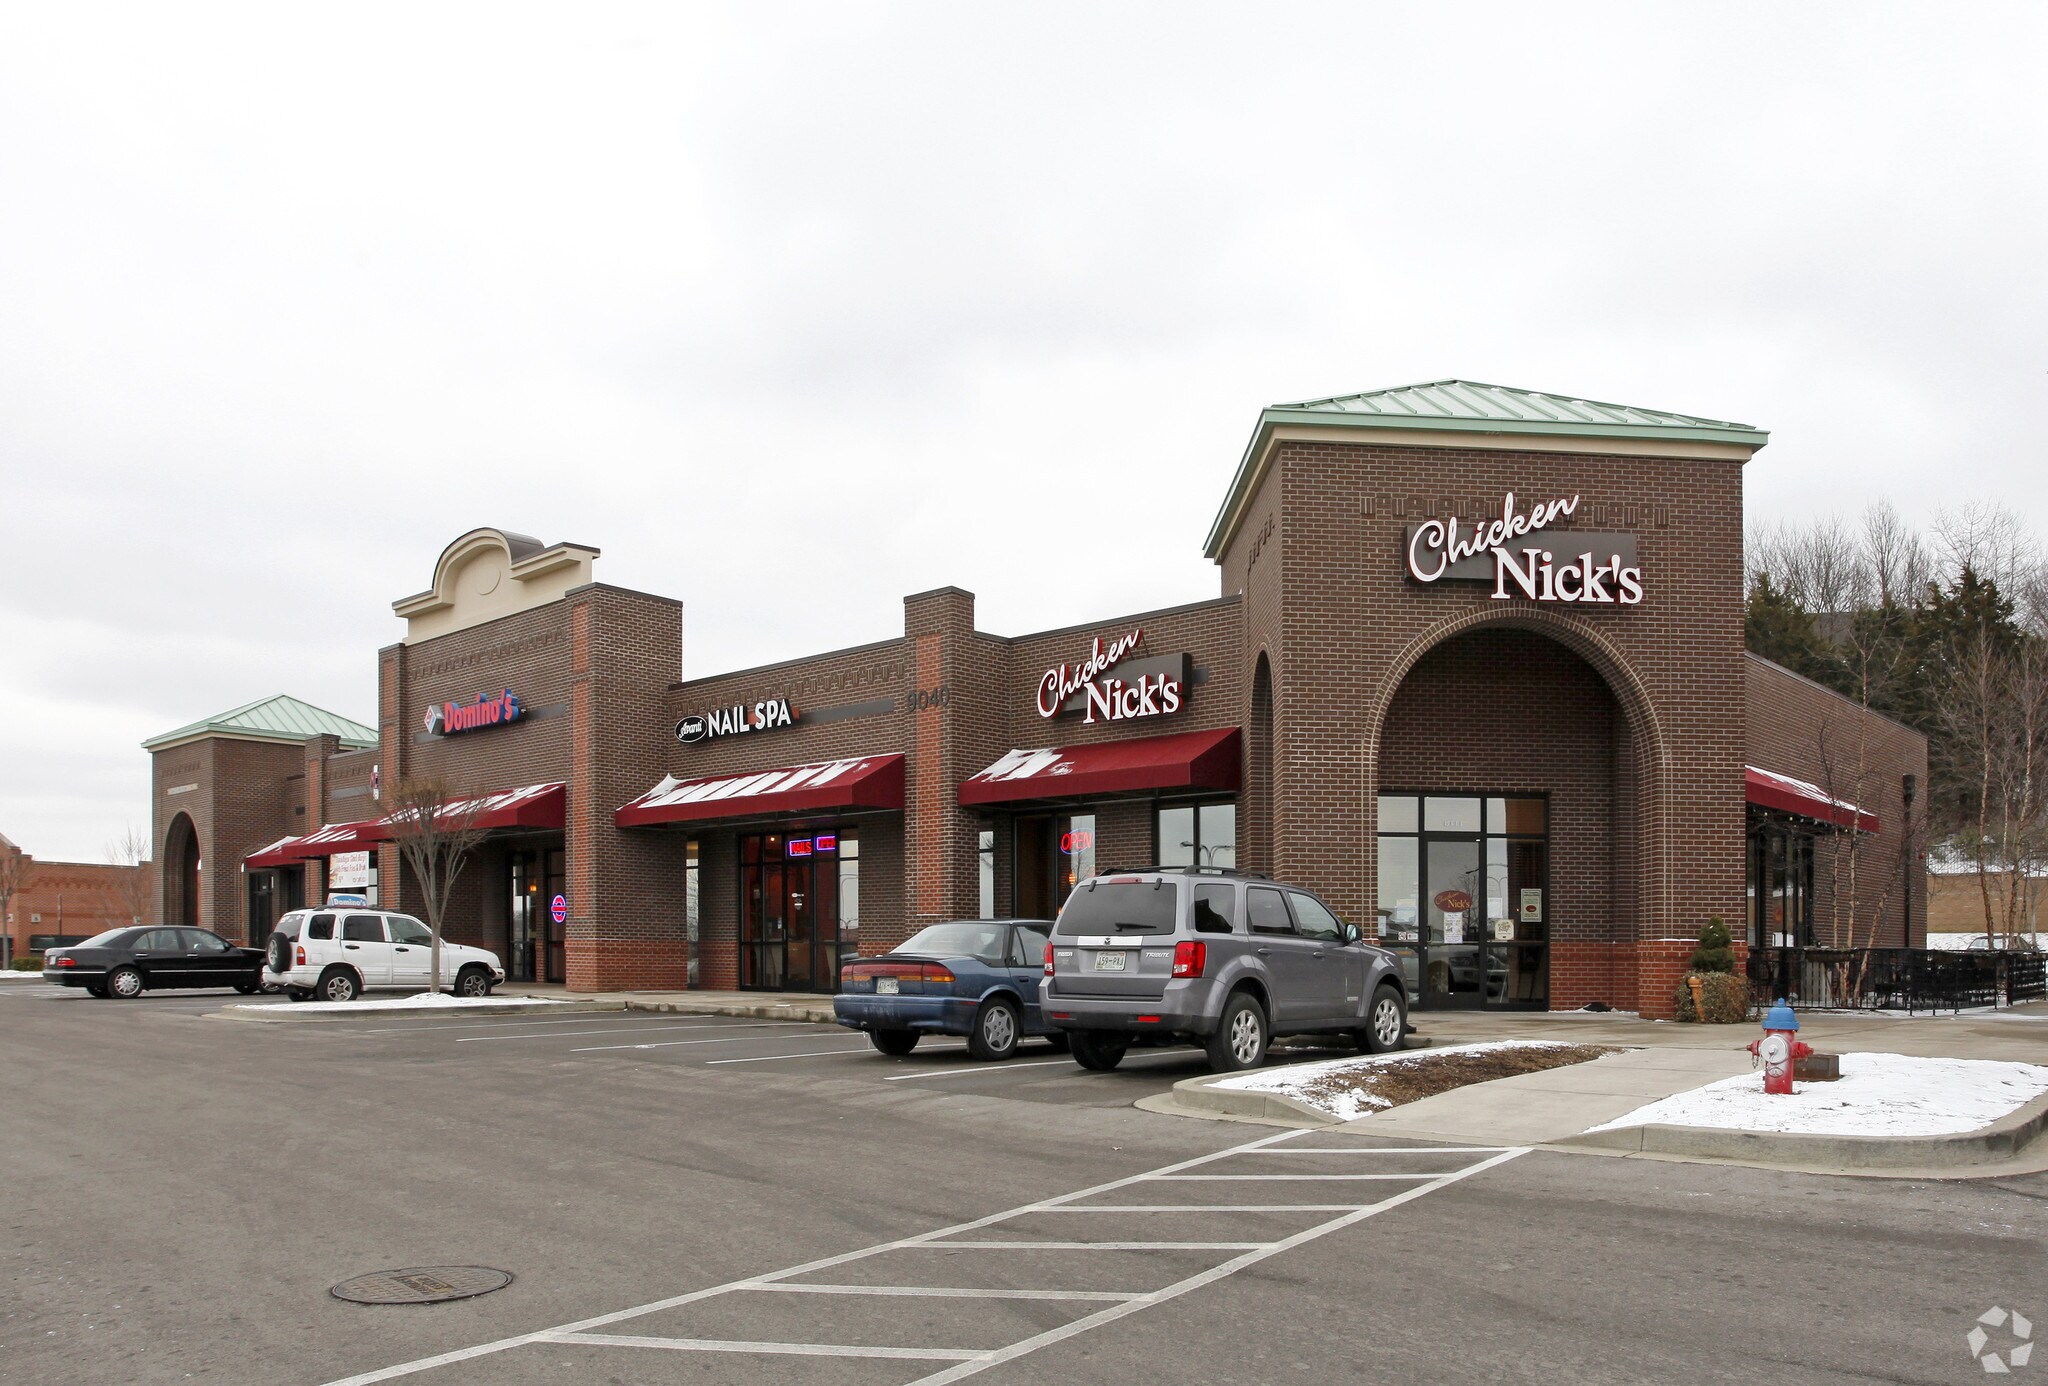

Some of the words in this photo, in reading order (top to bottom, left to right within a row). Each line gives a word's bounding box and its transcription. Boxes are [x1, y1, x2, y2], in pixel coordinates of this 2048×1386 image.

[1409, 491, 1580, 582] Chicken
[1490, 546, 1644, 605] Nick's
[1037, 628, 1140, 718] Chicken
[444, 687, 514, 733] Domino's
[707, 705, 750, 738] NAIL
[754, 698, 792, 730] SPA
[907, 684, 950, 713] 9040
[1082, 672, 1180, 724] Nick's
[791, 842, 812, 854] NAILS
[1061, 831, 1093, 850] OPEN
[333, 898, 367, 906] Domino's
[1448, 899, 1470, 909] Nick's
